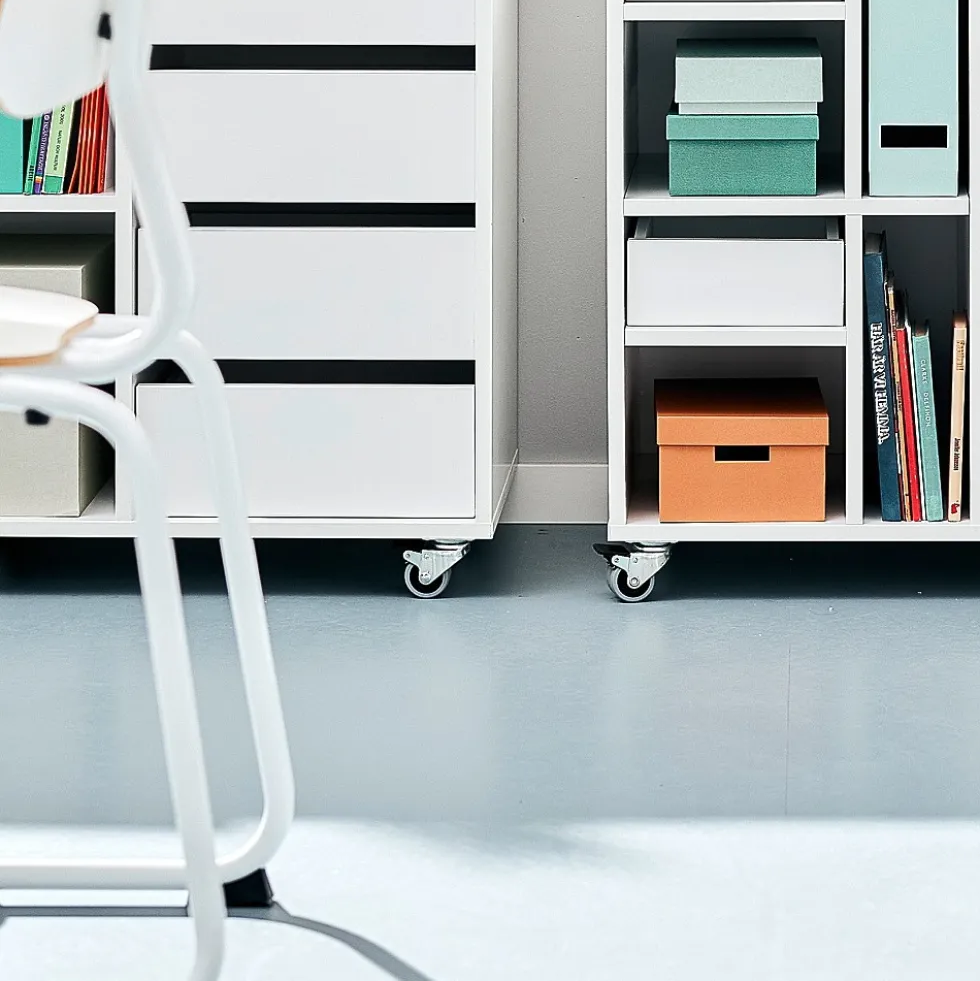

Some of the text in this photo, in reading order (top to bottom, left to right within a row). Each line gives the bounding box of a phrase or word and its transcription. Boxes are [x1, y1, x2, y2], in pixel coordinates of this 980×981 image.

[870, 322, 885, 352] HÄR
[874, 373, 887, 391] VI
[919, 359, 927, 384] CLARKE
